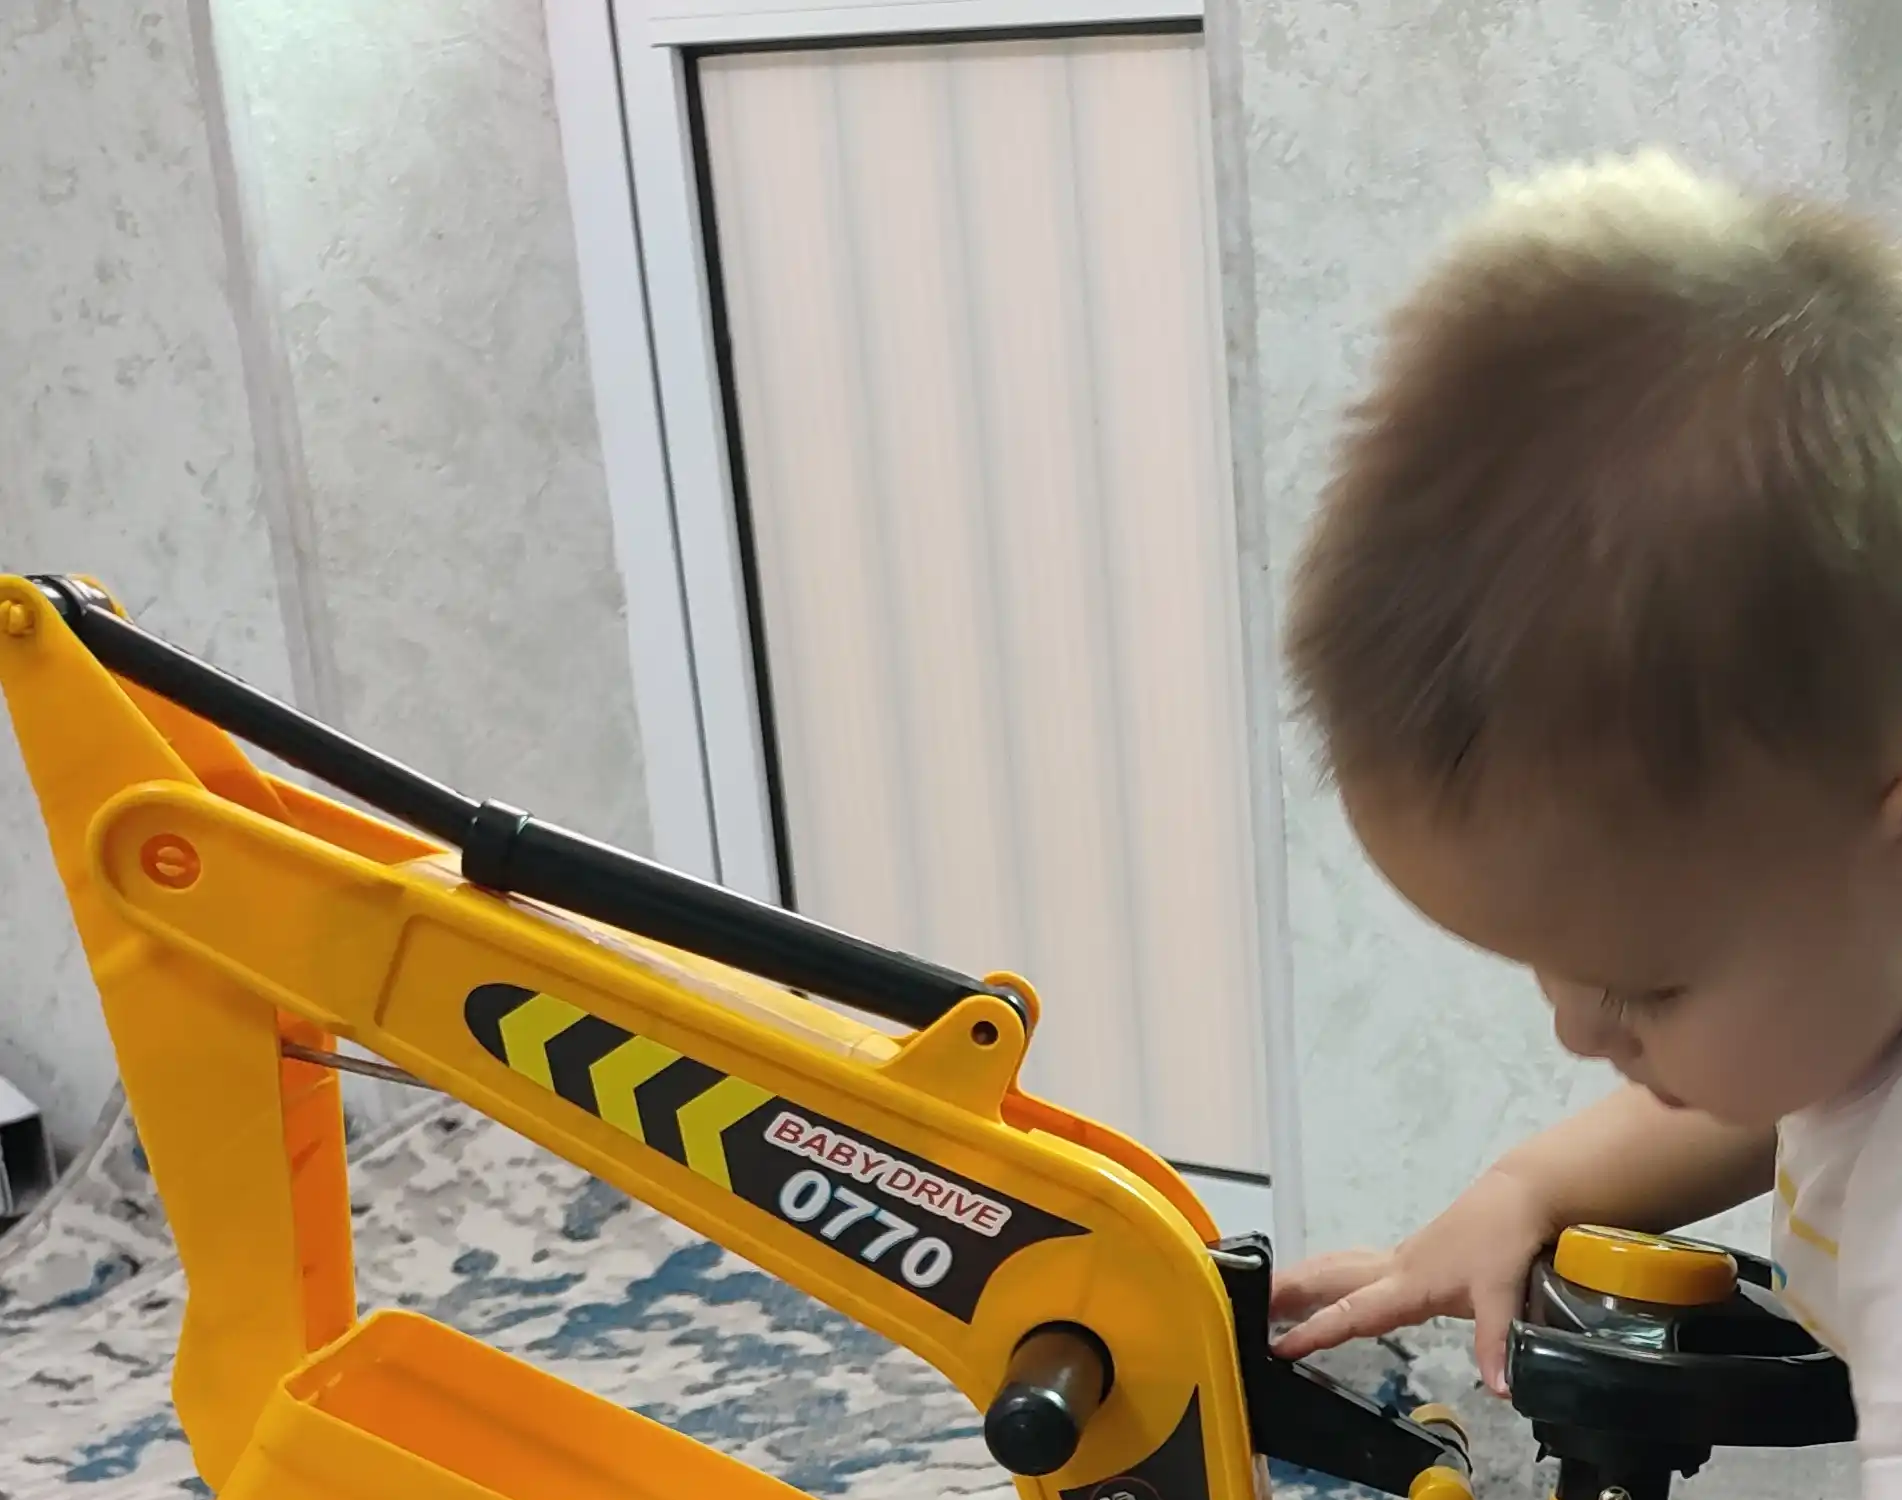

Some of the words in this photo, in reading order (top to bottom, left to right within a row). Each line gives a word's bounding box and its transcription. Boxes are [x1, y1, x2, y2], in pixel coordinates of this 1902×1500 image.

[773, 1118, 885, 1176] BABY
[886, 1167, 1004, 1230] DRIVE
[779, 1168, 953, 1289] 0770
